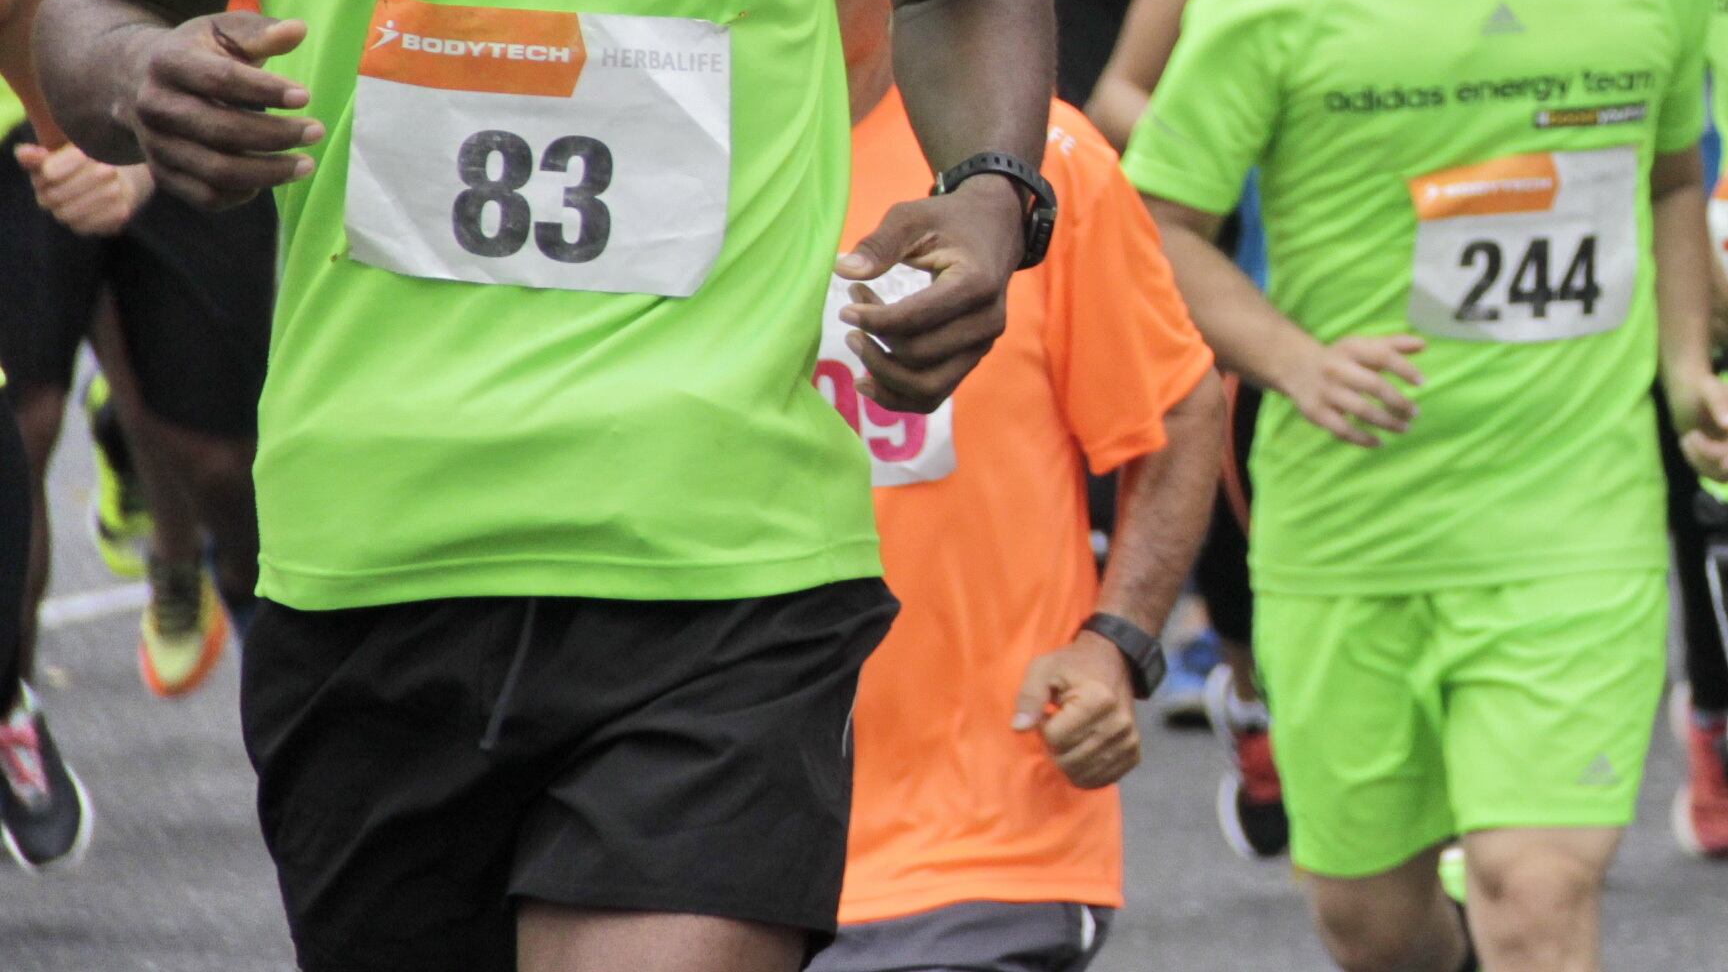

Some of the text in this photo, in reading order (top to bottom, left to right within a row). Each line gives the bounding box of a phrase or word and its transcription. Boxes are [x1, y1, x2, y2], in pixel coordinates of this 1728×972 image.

[402, 31, 724, 74] BODYTECH HERBALIFE
[1325, 83, 1445, 114] adidas
[1455, 75, 1574, 104] energy
[452, 129, 614, 264] 83
[1454, 235, 1604, 322] 244
